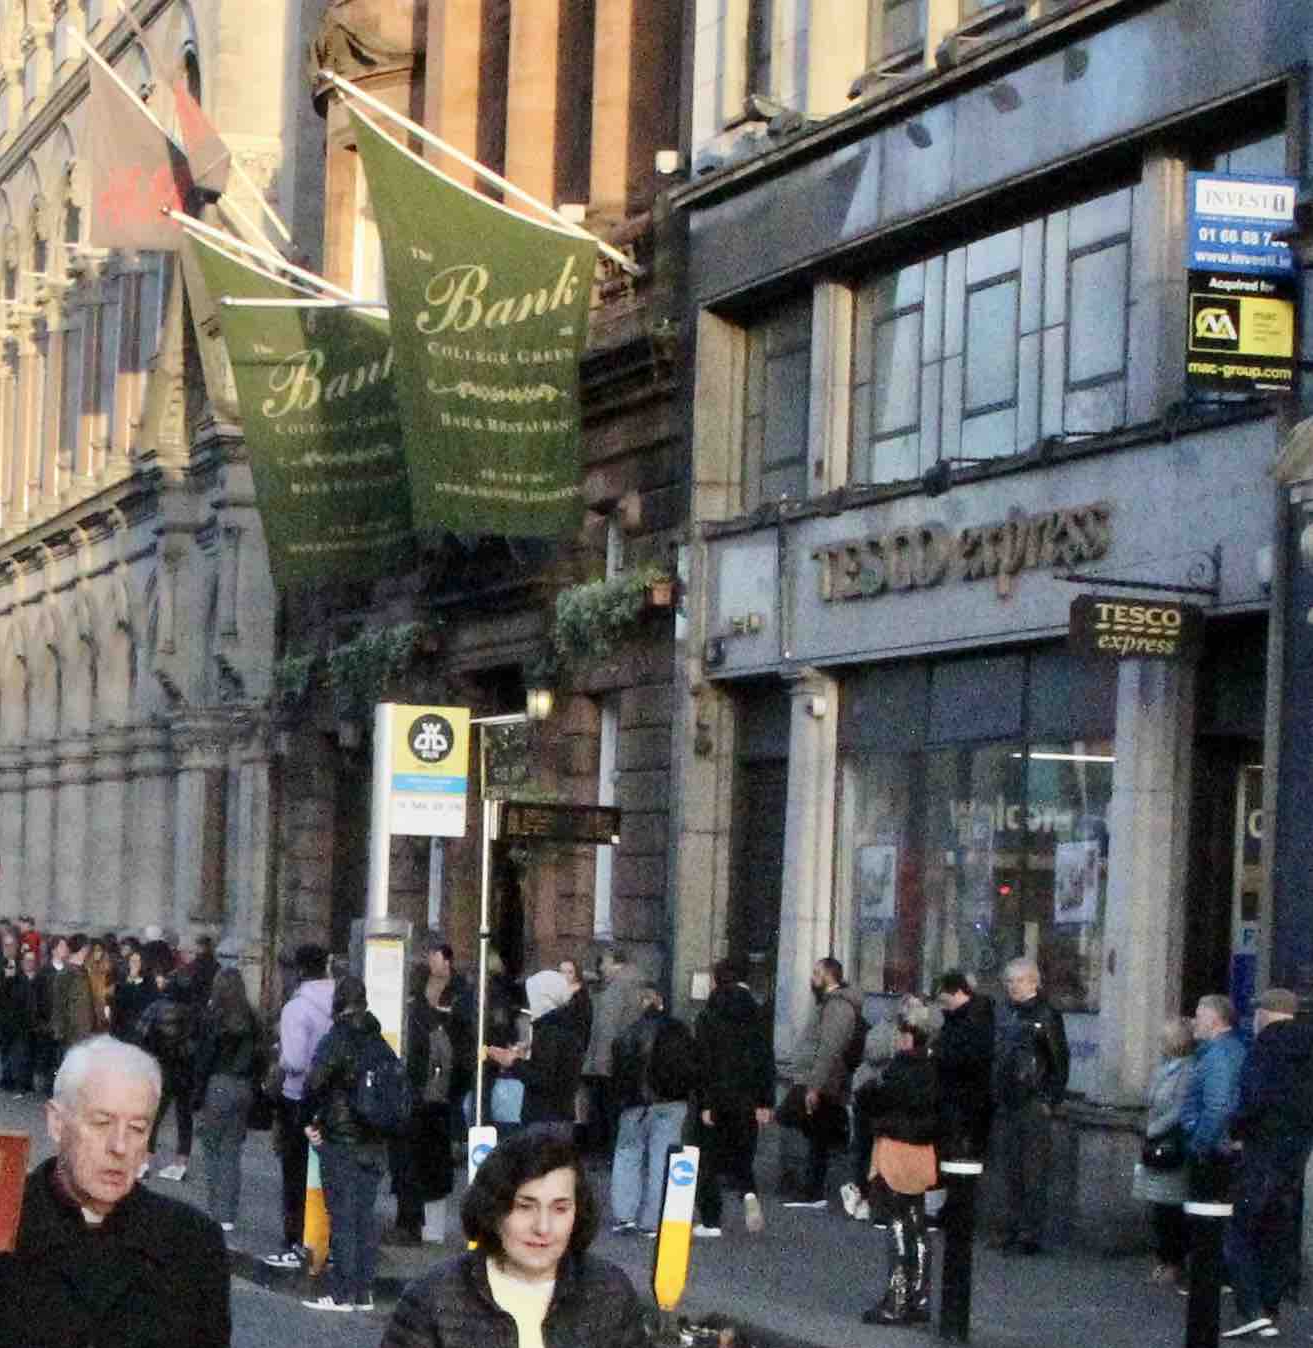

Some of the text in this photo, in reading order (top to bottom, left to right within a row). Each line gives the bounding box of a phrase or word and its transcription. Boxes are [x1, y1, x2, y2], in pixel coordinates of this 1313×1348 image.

[416, 255, 579, 334] Bank
[1094, 603, 1182, 627] TESCO
[1098, 633, 1175, 657] express
